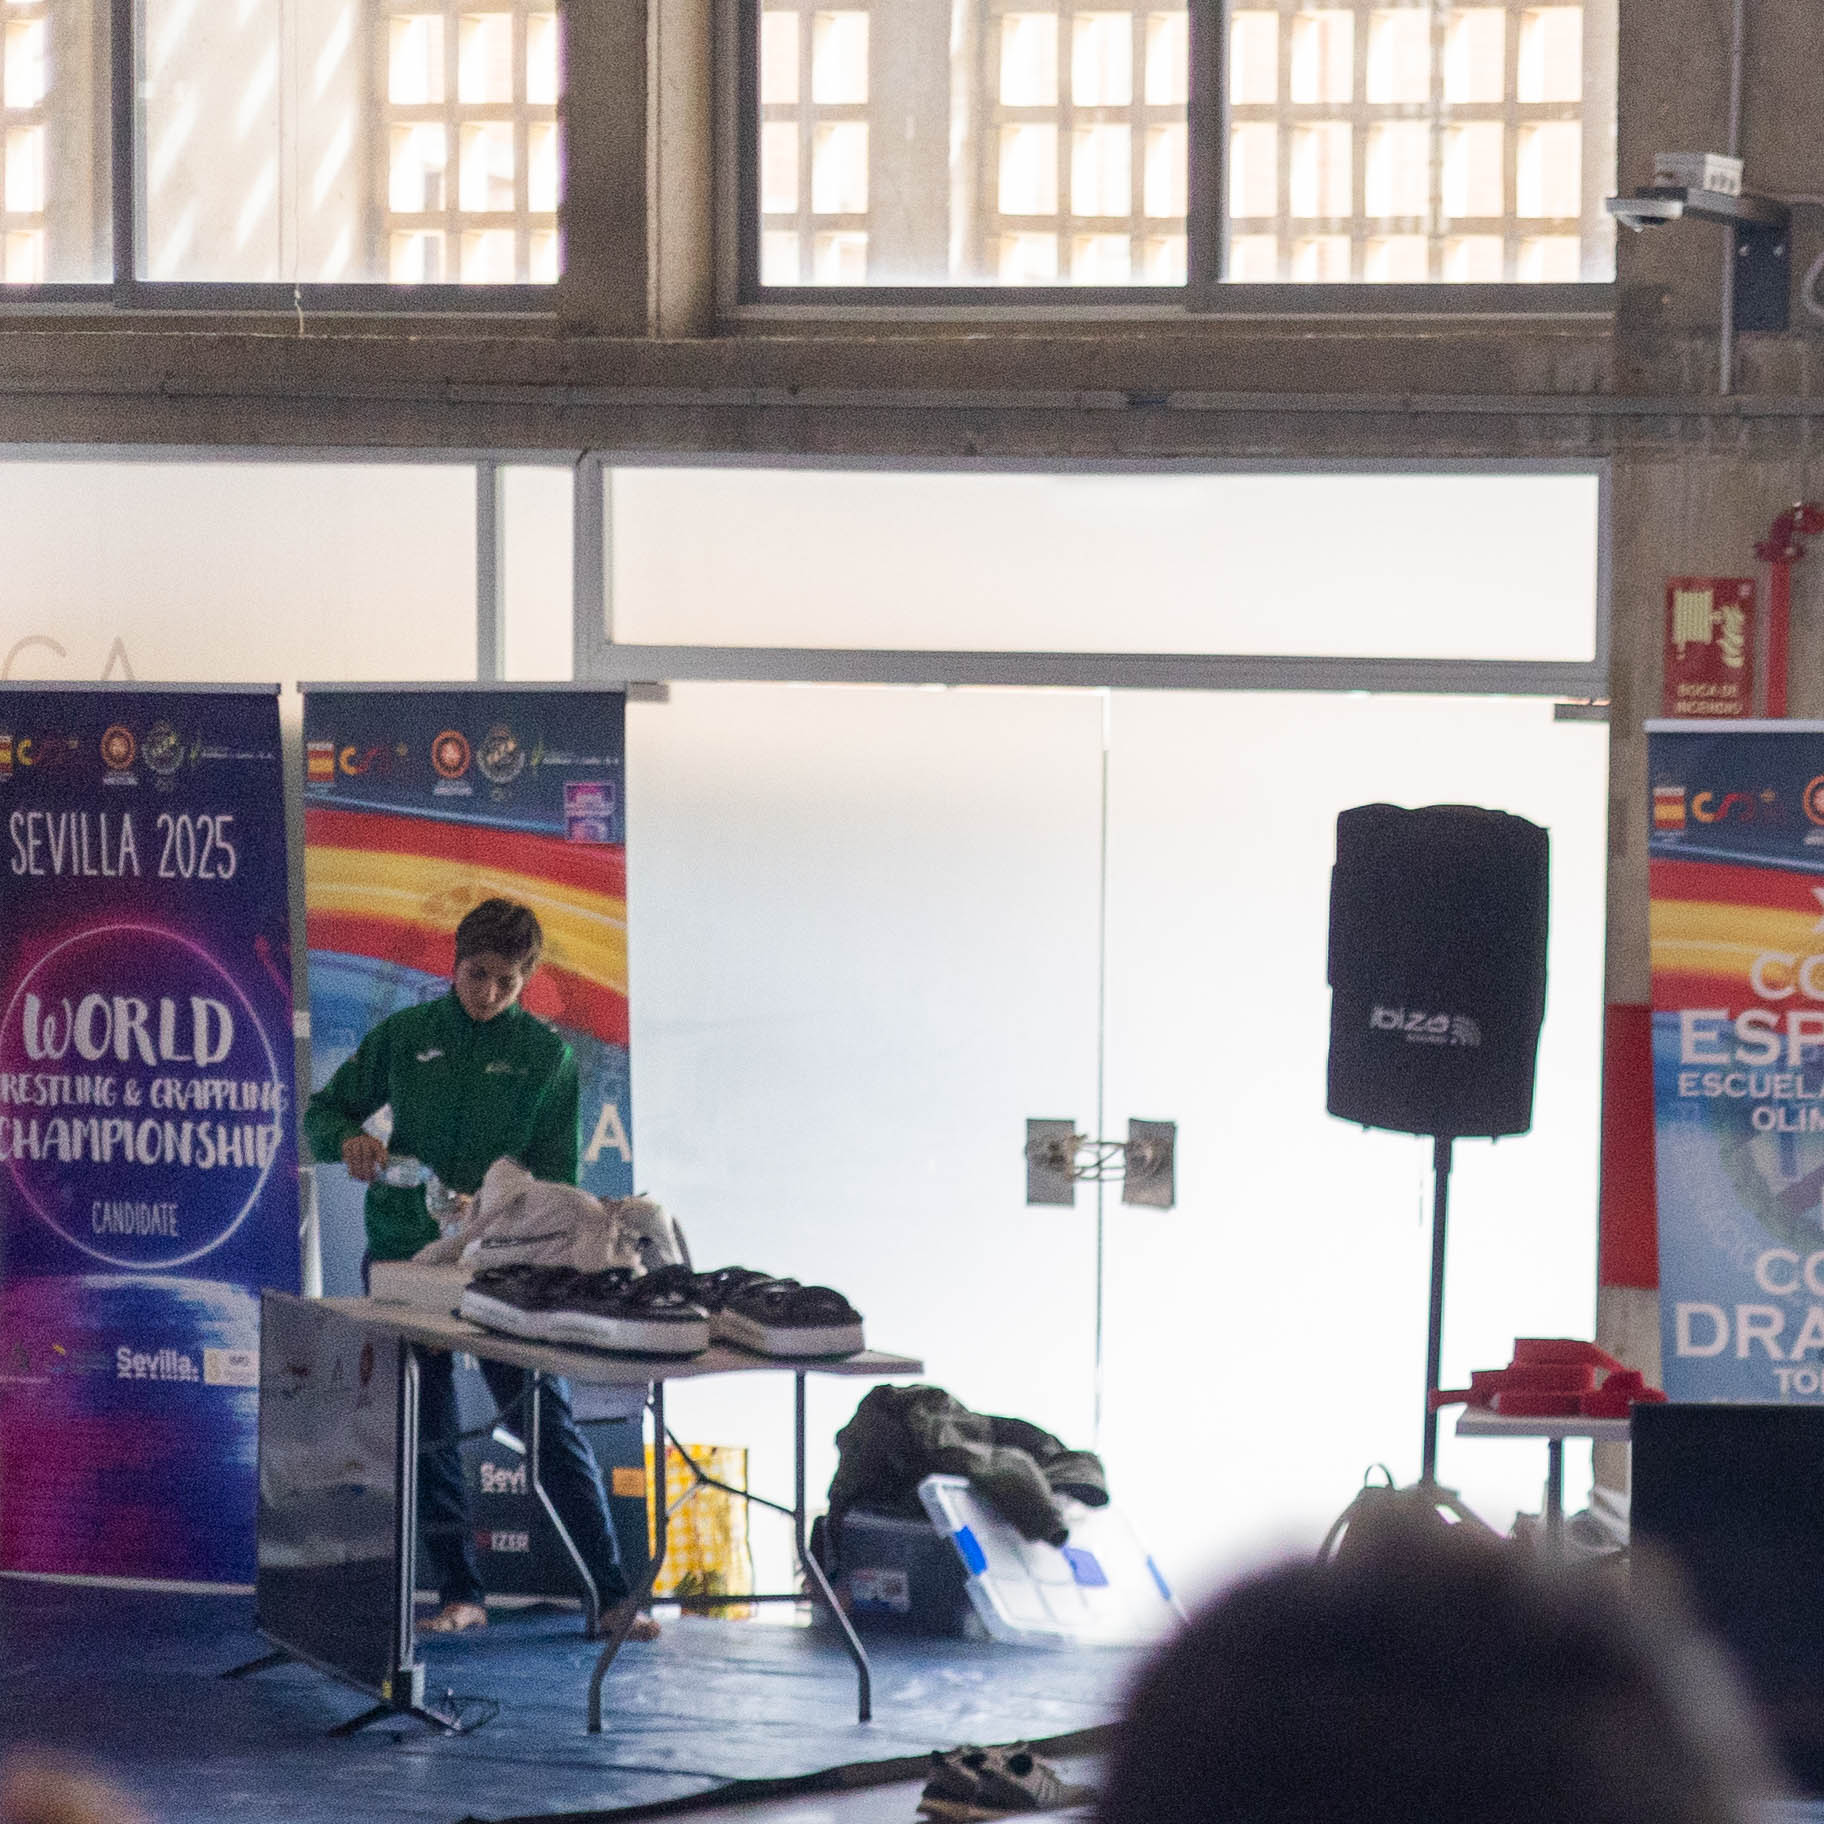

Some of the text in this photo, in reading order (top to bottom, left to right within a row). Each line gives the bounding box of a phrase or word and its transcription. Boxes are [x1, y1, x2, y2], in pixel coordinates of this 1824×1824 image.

[10, 811, 236, 880] SEVILLA 2025
[22, 993, 234, 1067] WORLD
[0, 1073, 289, 1111] RESTLING & GRAPPLING
[92, 1201, 179, 1237] CANDIDATE
